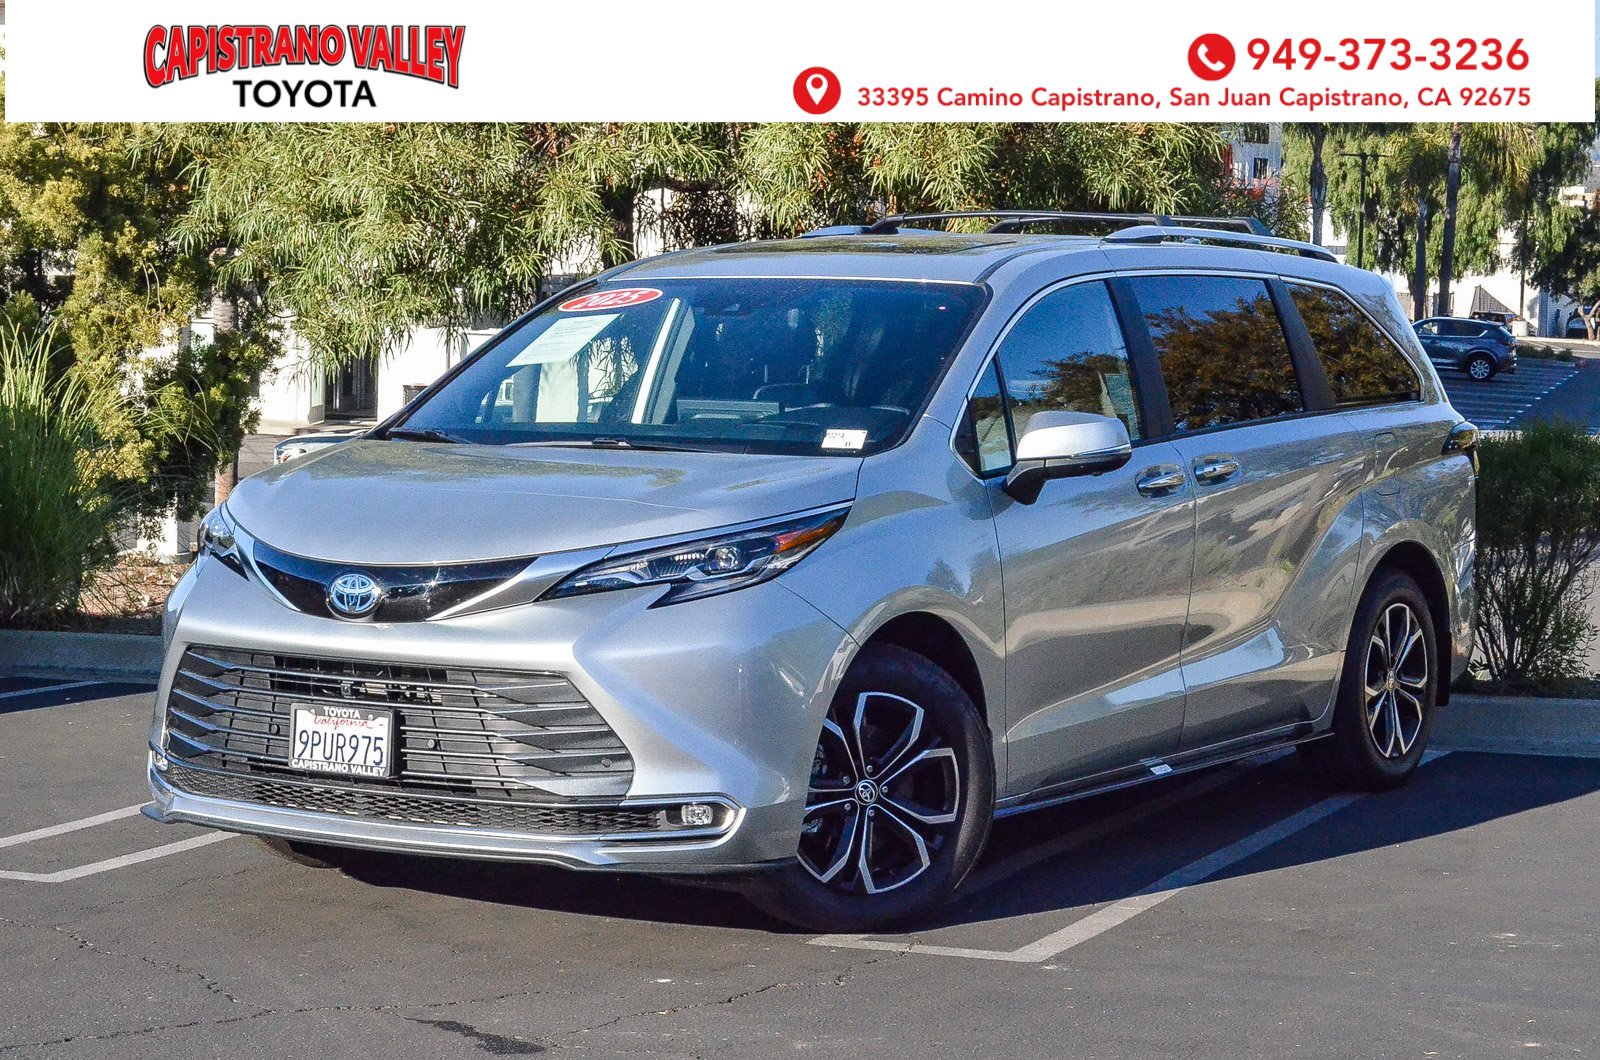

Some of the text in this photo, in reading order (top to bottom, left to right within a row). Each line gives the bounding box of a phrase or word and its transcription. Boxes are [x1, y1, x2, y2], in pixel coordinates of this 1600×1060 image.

[569, 289, 651, 309] 2025
[323, 706, 361, 719] TOYOTA
[313, 715, 369, 730] California
[297, 729, 384, 766] 9PUR975
[291, 758, 385, 777] CAPISTRANO VALLEY
